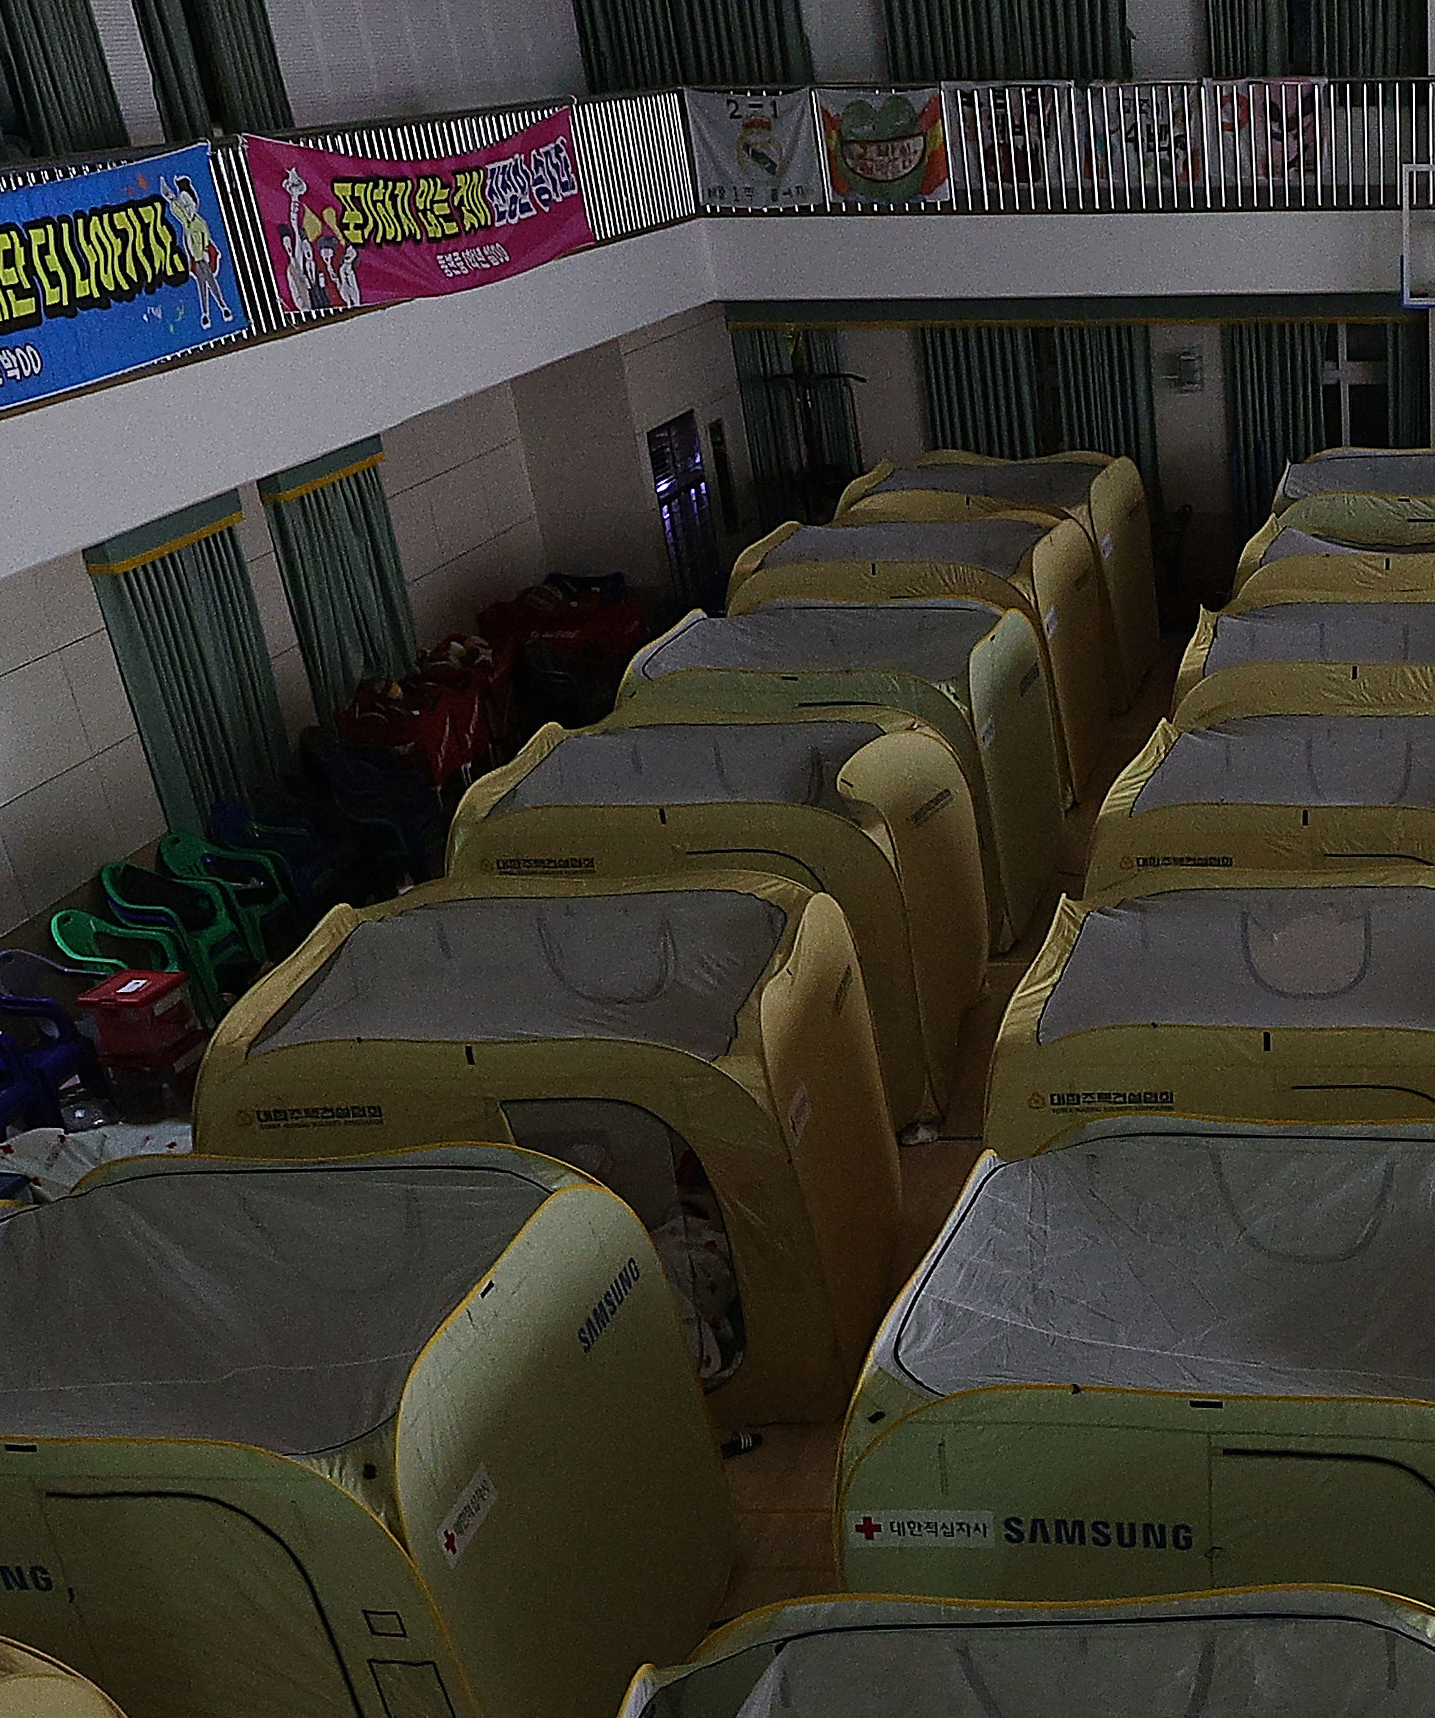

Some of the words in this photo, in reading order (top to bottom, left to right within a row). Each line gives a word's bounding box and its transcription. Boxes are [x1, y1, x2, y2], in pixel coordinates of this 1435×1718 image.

[333, 178, 421, 244] 포기하지
[415, 176, 459, 238] 않는
[454, 168, 492, 232] 것이
[28, 222, 69, 306] 더
[577, 1257, 641, 1354] SAMSUNG
[889, 1520, 988, 1538] 대한적십자사
[1004, 1515, 1194, 1551] SAMSUNG
